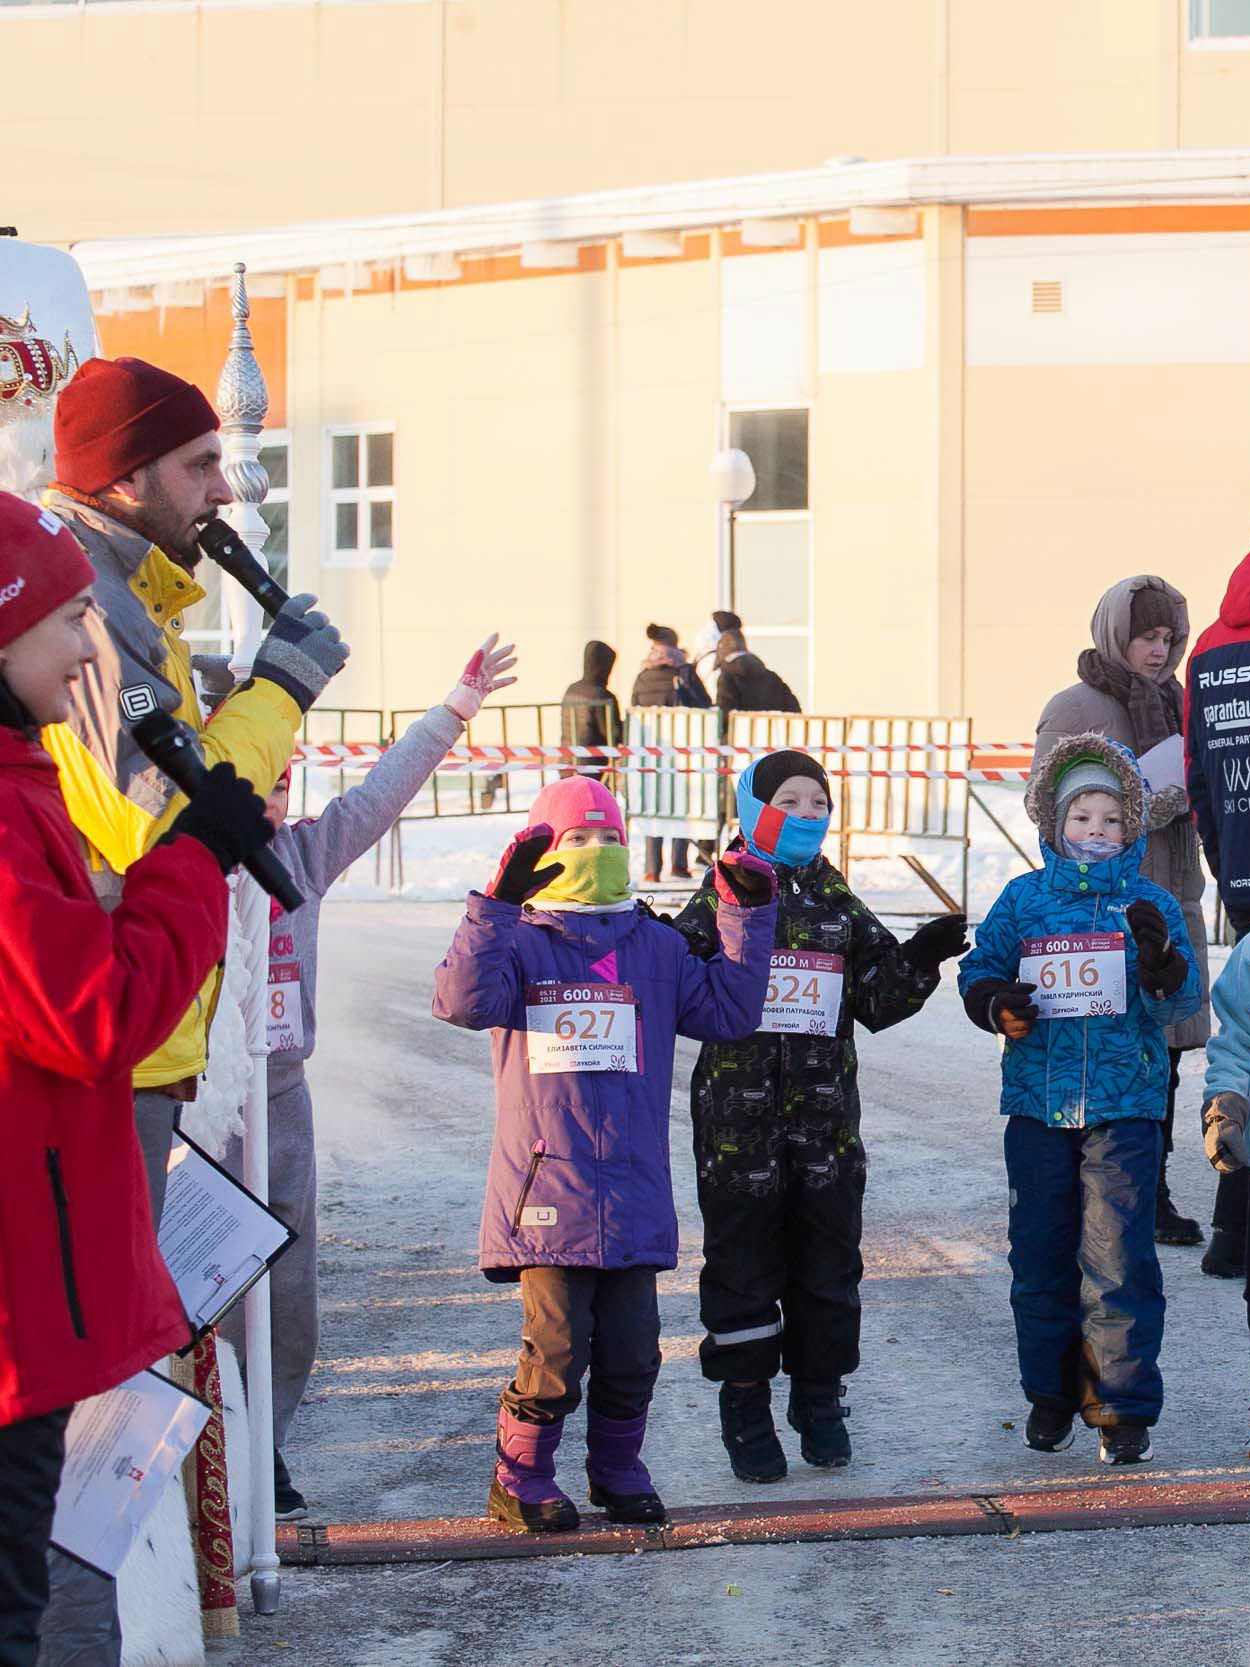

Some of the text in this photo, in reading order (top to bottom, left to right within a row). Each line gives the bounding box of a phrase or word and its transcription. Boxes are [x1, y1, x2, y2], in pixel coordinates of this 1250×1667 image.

[1207, 736, 1235, 750] GENERAL
[1224, 798, 1236, 814] SKI
[1046, 940, 1069, 952] 600
[770, 955, 796, 967] 600
[1040, 958, 1099, 989] 616
[563, 989, 591, 1001] 600
[555, 1010, 615, 1040] 627
